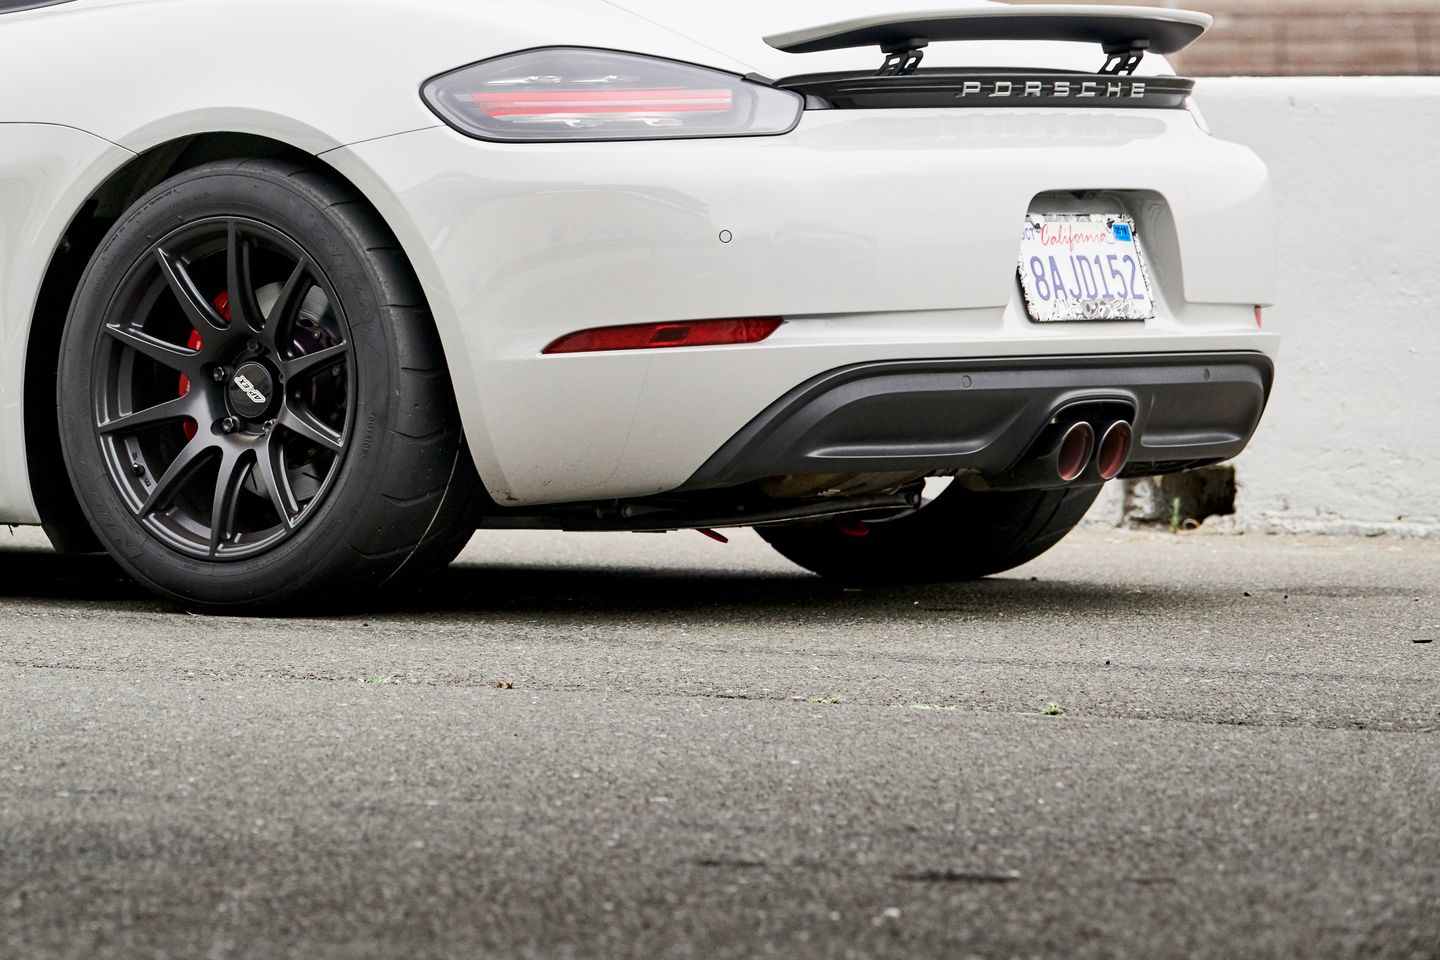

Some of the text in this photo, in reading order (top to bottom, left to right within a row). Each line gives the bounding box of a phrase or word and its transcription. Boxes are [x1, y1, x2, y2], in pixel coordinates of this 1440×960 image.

[957, 81, 1146, 98] PORSCHE
[1041, 223, 1106, 252] California
[1030, 255, 1145, 301] 8AJD152
